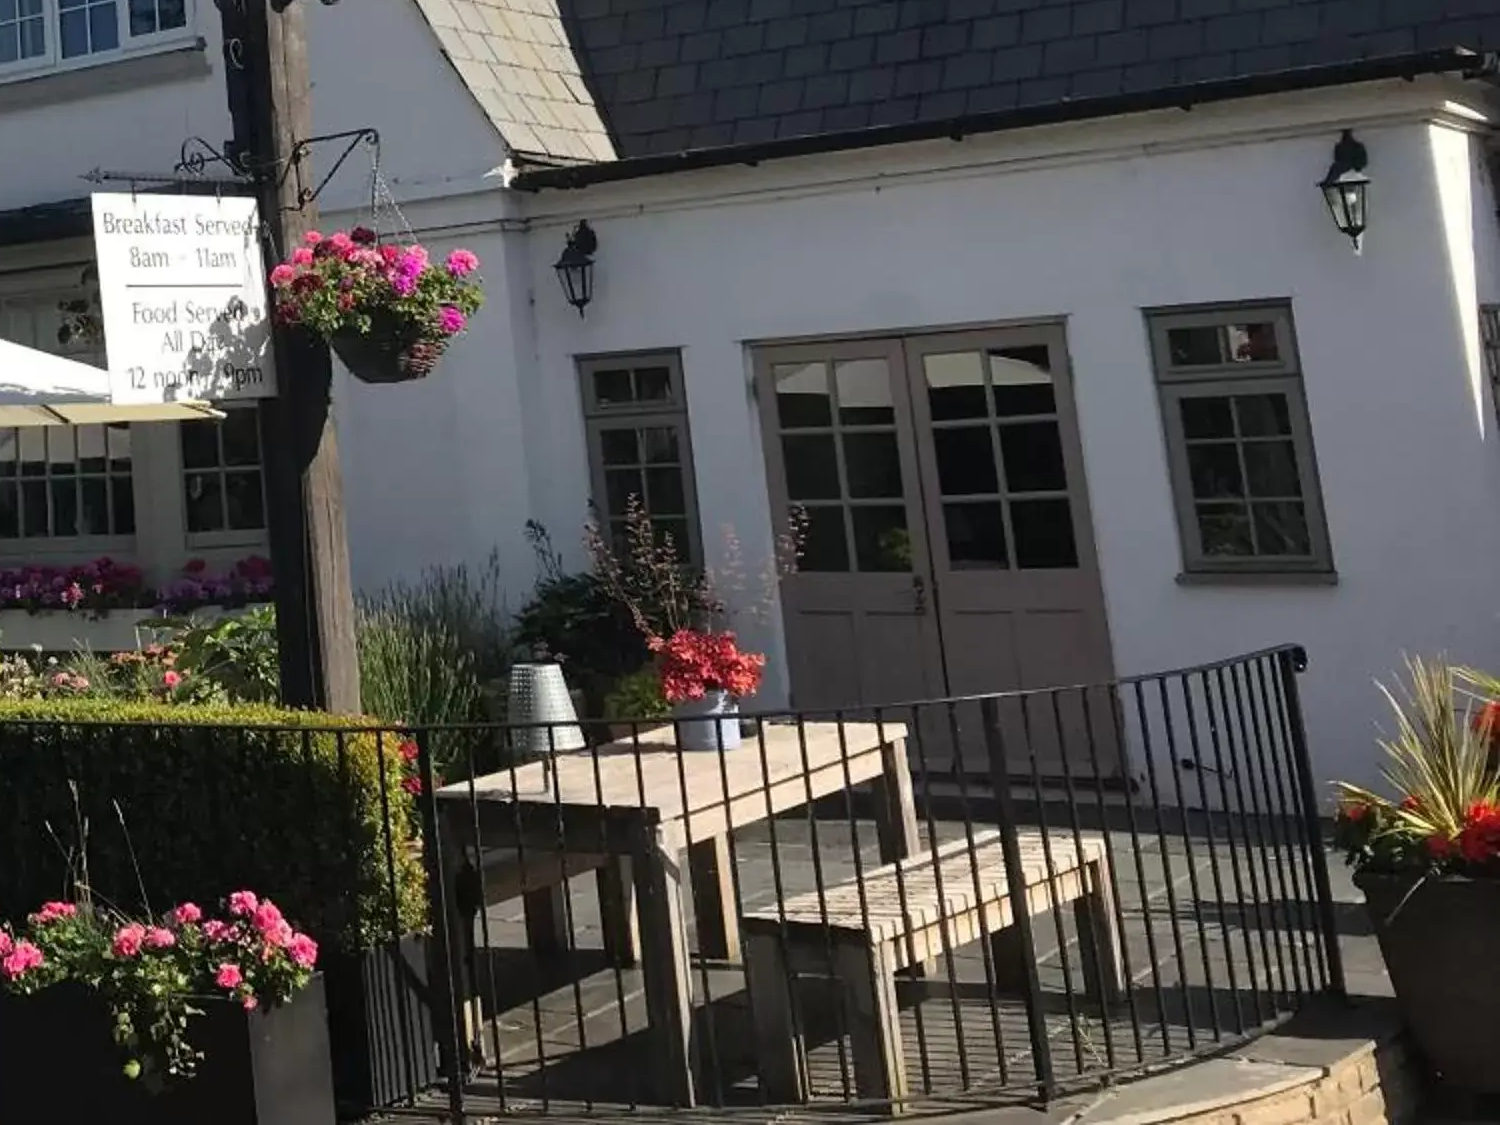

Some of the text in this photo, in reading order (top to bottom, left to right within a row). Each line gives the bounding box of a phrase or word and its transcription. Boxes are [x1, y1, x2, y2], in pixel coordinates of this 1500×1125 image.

[102, 210, 253, 236] Breakfast Served
[129, 246, 170, 268] 8am
[195, 247, 238, 268] 11am
[132, 300, 245, 324] Food Served
[161, 330, 184, 353] All
[126, 365, 147, 389] 12
[153, 370, 200, 390] noon
[223, 363, 264, 392] 9pm
